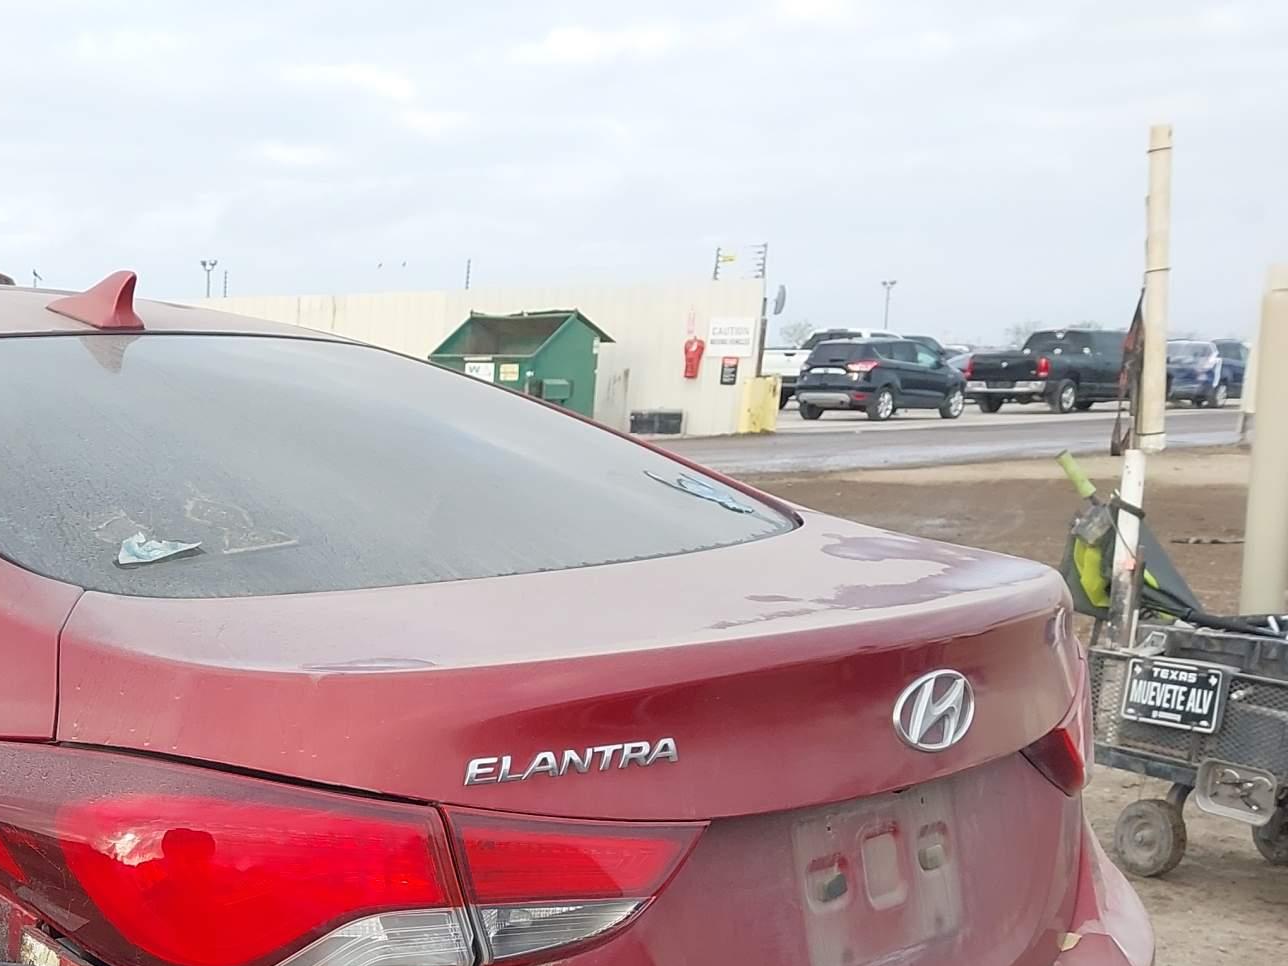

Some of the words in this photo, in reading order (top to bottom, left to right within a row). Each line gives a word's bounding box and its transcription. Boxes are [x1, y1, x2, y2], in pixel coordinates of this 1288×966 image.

[1151, 666, 1198, 684] TEXAS
[1128, 679, 1189, 711] MUEVETE
[1185, 687, 1214, 715] ALV
[463, 737, 679, 786] ELANTRA
